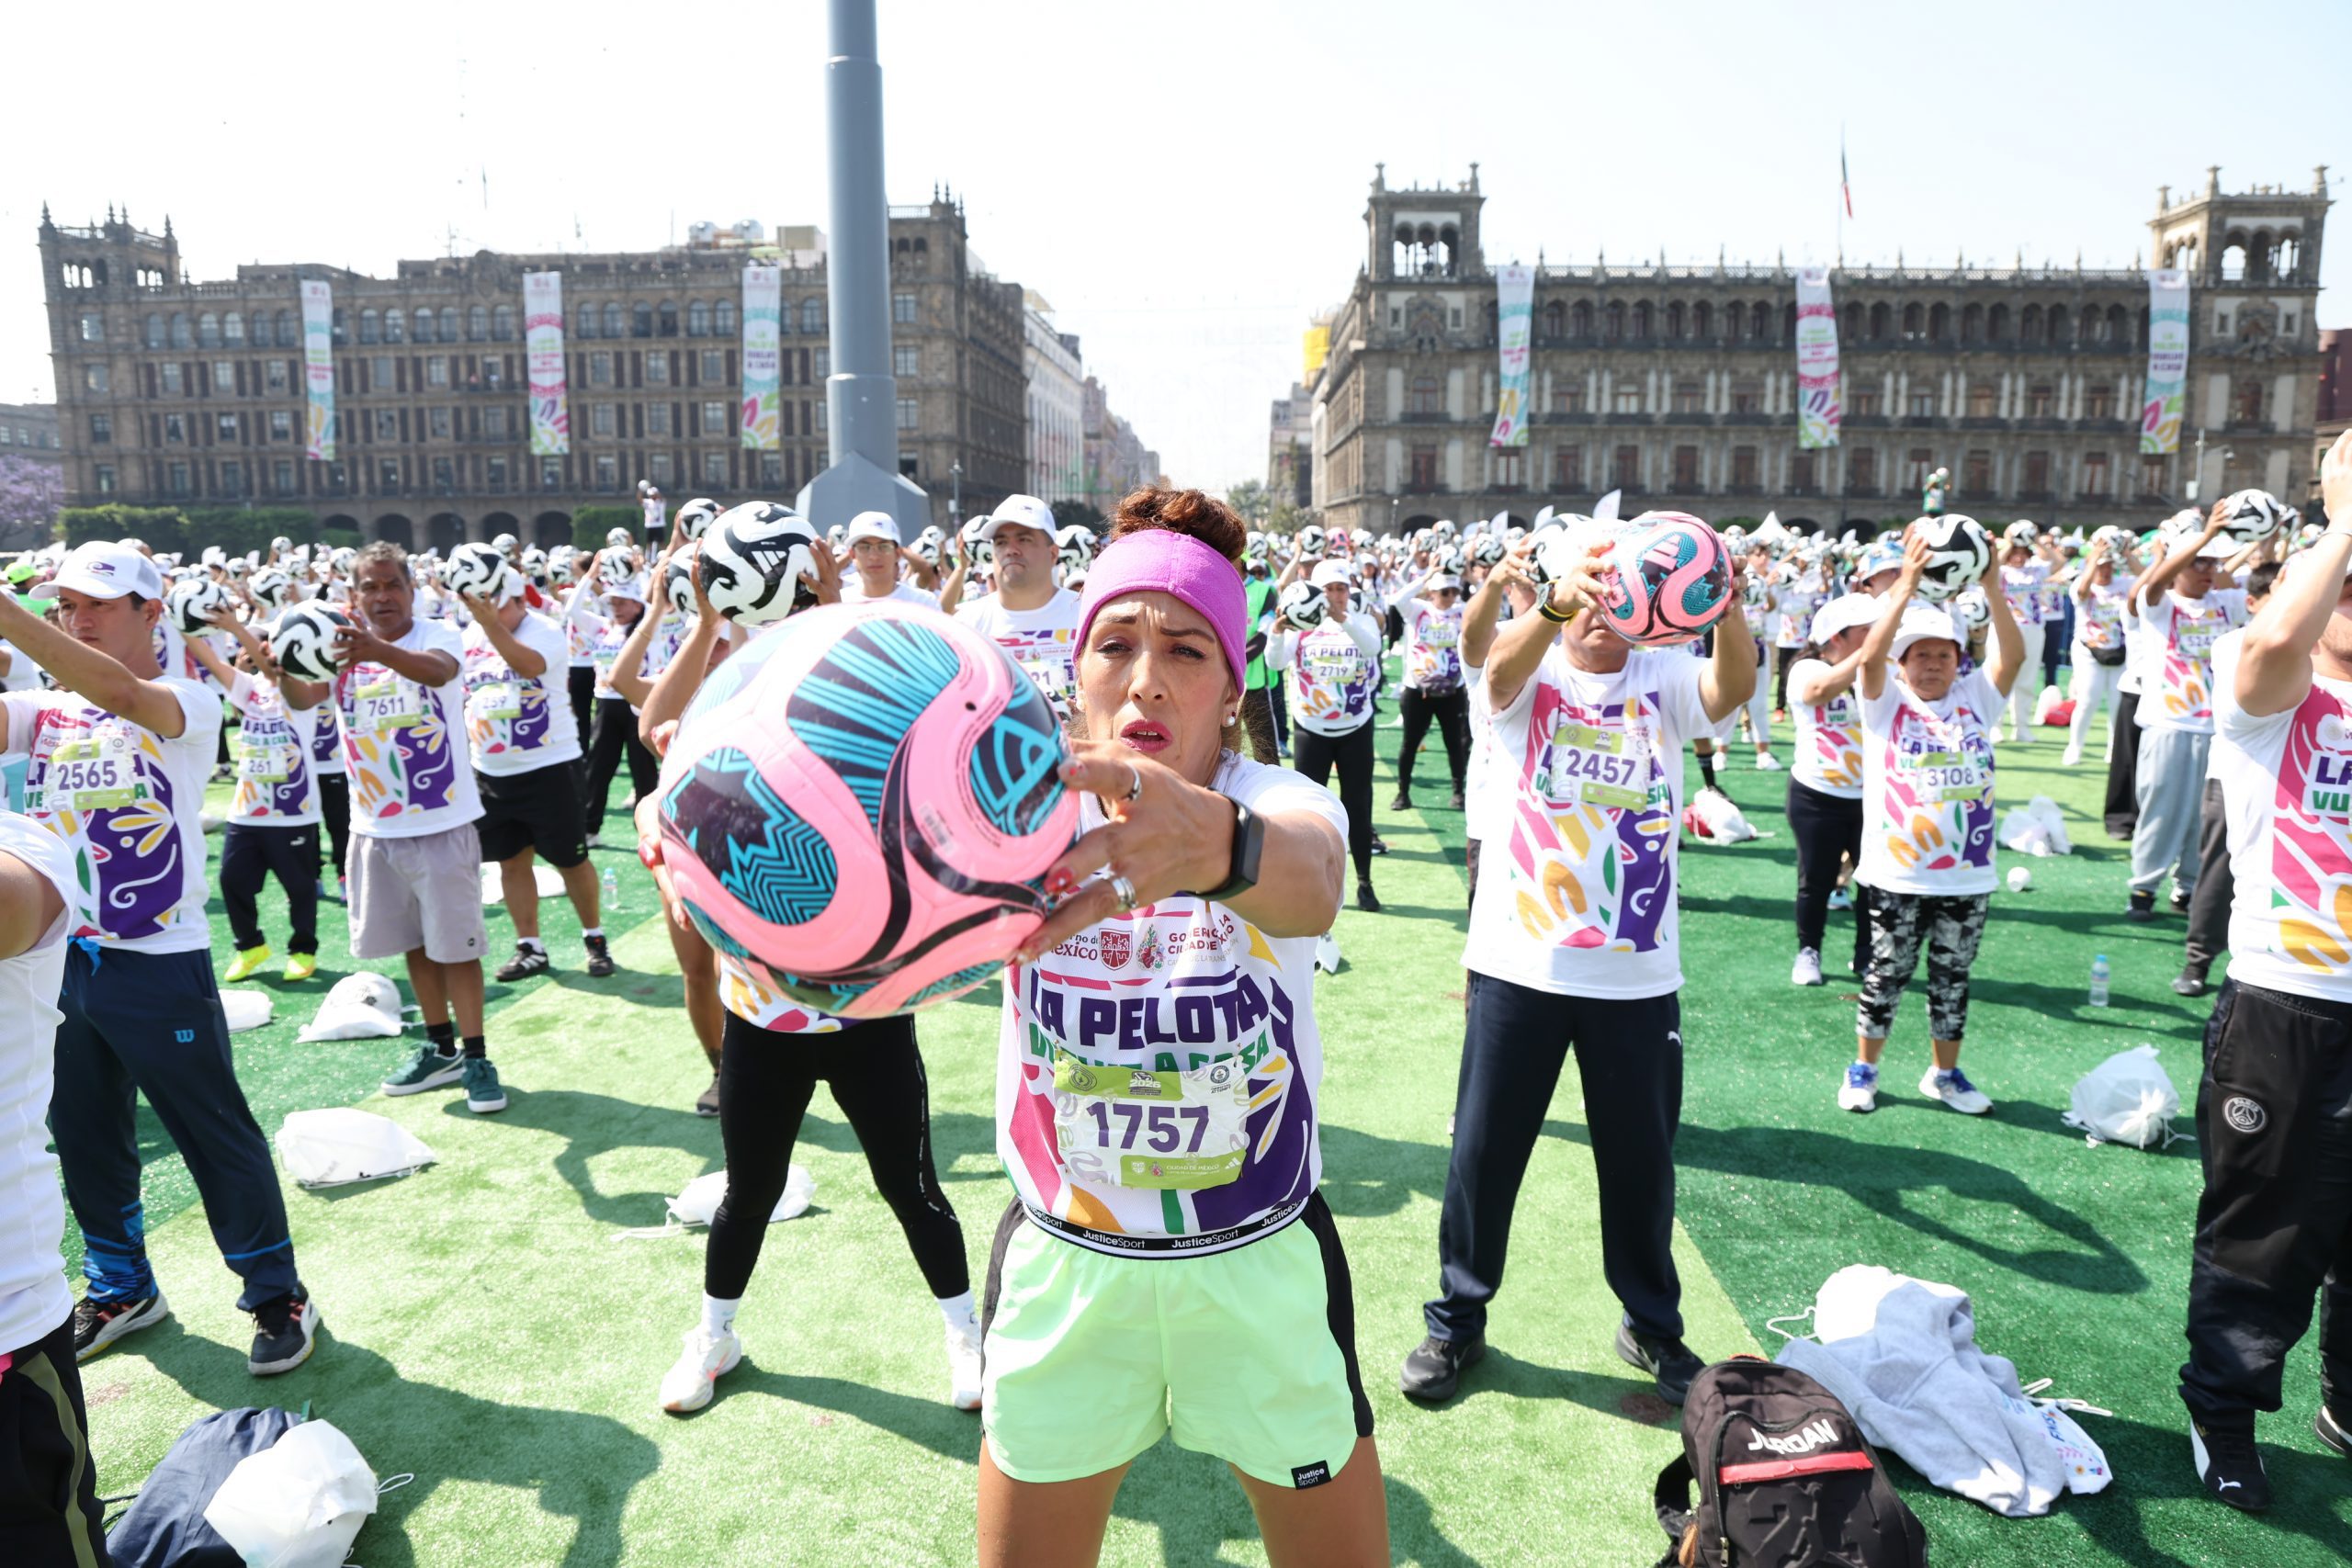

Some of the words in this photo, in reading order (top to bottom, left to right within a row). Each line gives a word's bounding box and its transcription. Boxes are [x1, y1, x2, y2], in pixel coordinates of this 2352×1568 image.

[1321, 647, 1363, 659] PELOT
[1319, 666, 1348, 677] 2719
[368, 696, 404, 717] 7611
[57, 761, 118, 791] 2565
[249, 760, 271, 773] 261
[1566, 749, 1636, 786] 2457
[1928, 766, 1974, 787] 3108
[1030, 967, 1067, 1042] LA
[1080, 973, 1270, 1051] PELOTA
[1086, 1101, 1210, 1153] 1757
[1083, 1230, 1146, 1249] JusticeSport
[1171, 1229, 1239, 1249] JusticeSport
[1297, 1468, 1325, 1481] Justice
[1298, 1476, 1319, 1486] Sport
